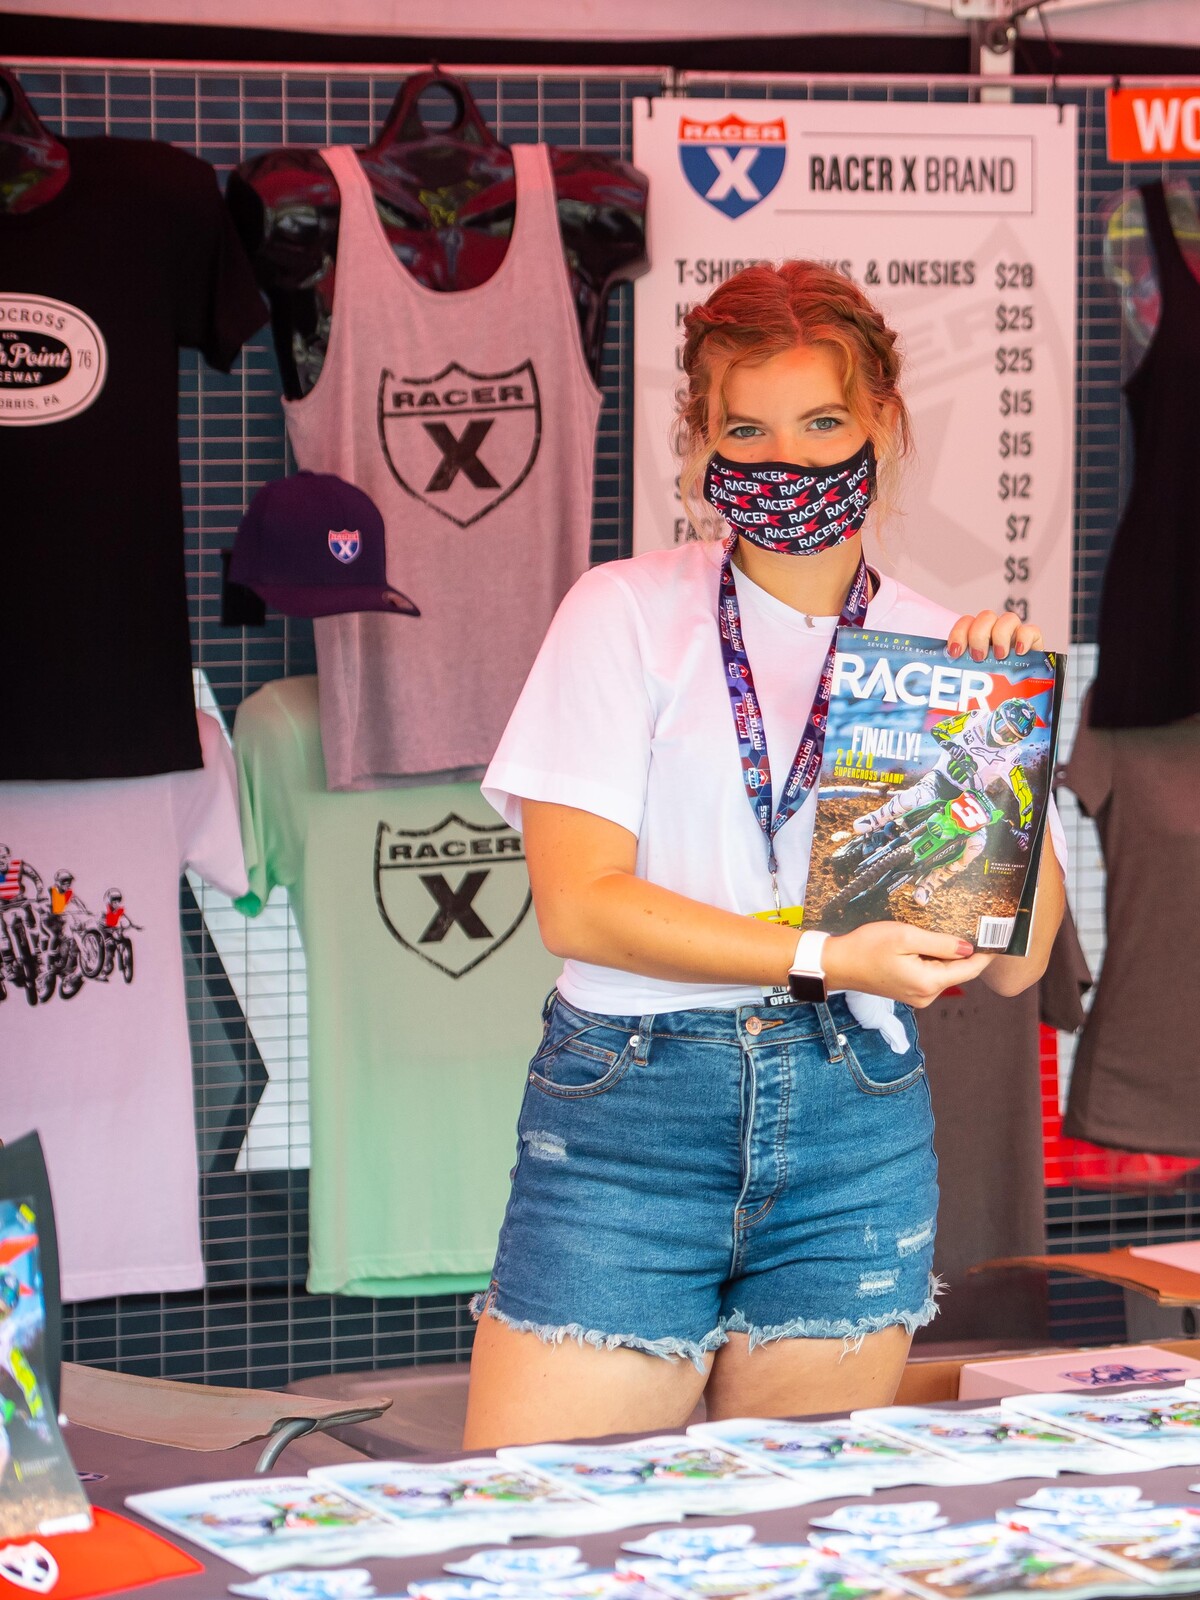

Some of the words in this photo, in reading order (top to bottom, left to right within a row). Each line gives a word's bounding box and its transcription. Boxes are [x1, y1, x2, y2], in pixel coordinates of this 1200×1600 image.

[683, 124, 783, 140] RACER
[704, 147, 762, 201] X
[809, 155, 893, 192] RACER
[901, 156, 917, 193] X
[926, 157, 1015, 193] BRAND
[864, 260, 881, 284] &
[887, 260, 976, 286] ONESIES
[995, 304, 1034, 332] $25
[77, 348, 92, 369] 76
[995, 347, 1033, 375] $25
[392, 385, 524, 409] RACER
[999, 387, 1033, 416] $15
[422, 417, 502, 493] X
[999, 431, 1032, 459] $15
[998, 472, 1032, 500] $12
[1006, 513, 1031, 542] $7
[1004, 555, 1030, 584] $5
[853, 633, 911, 646] INSIDE
[867, 641, 889, 650] SEVEN
[915, 648, 937, 656] RACES
[745, 693, 761, 750] MOTOCROSS
[851, 725, 922, 762] FINALLY!
[835, 748, 874, 769] 2020
[833, 766, 878, 781] SUPERCROSS
[880, 772, 905, 784] CHAMP
[389, 834, 522, 862] RACER
[418, 871, 494, 944] X
